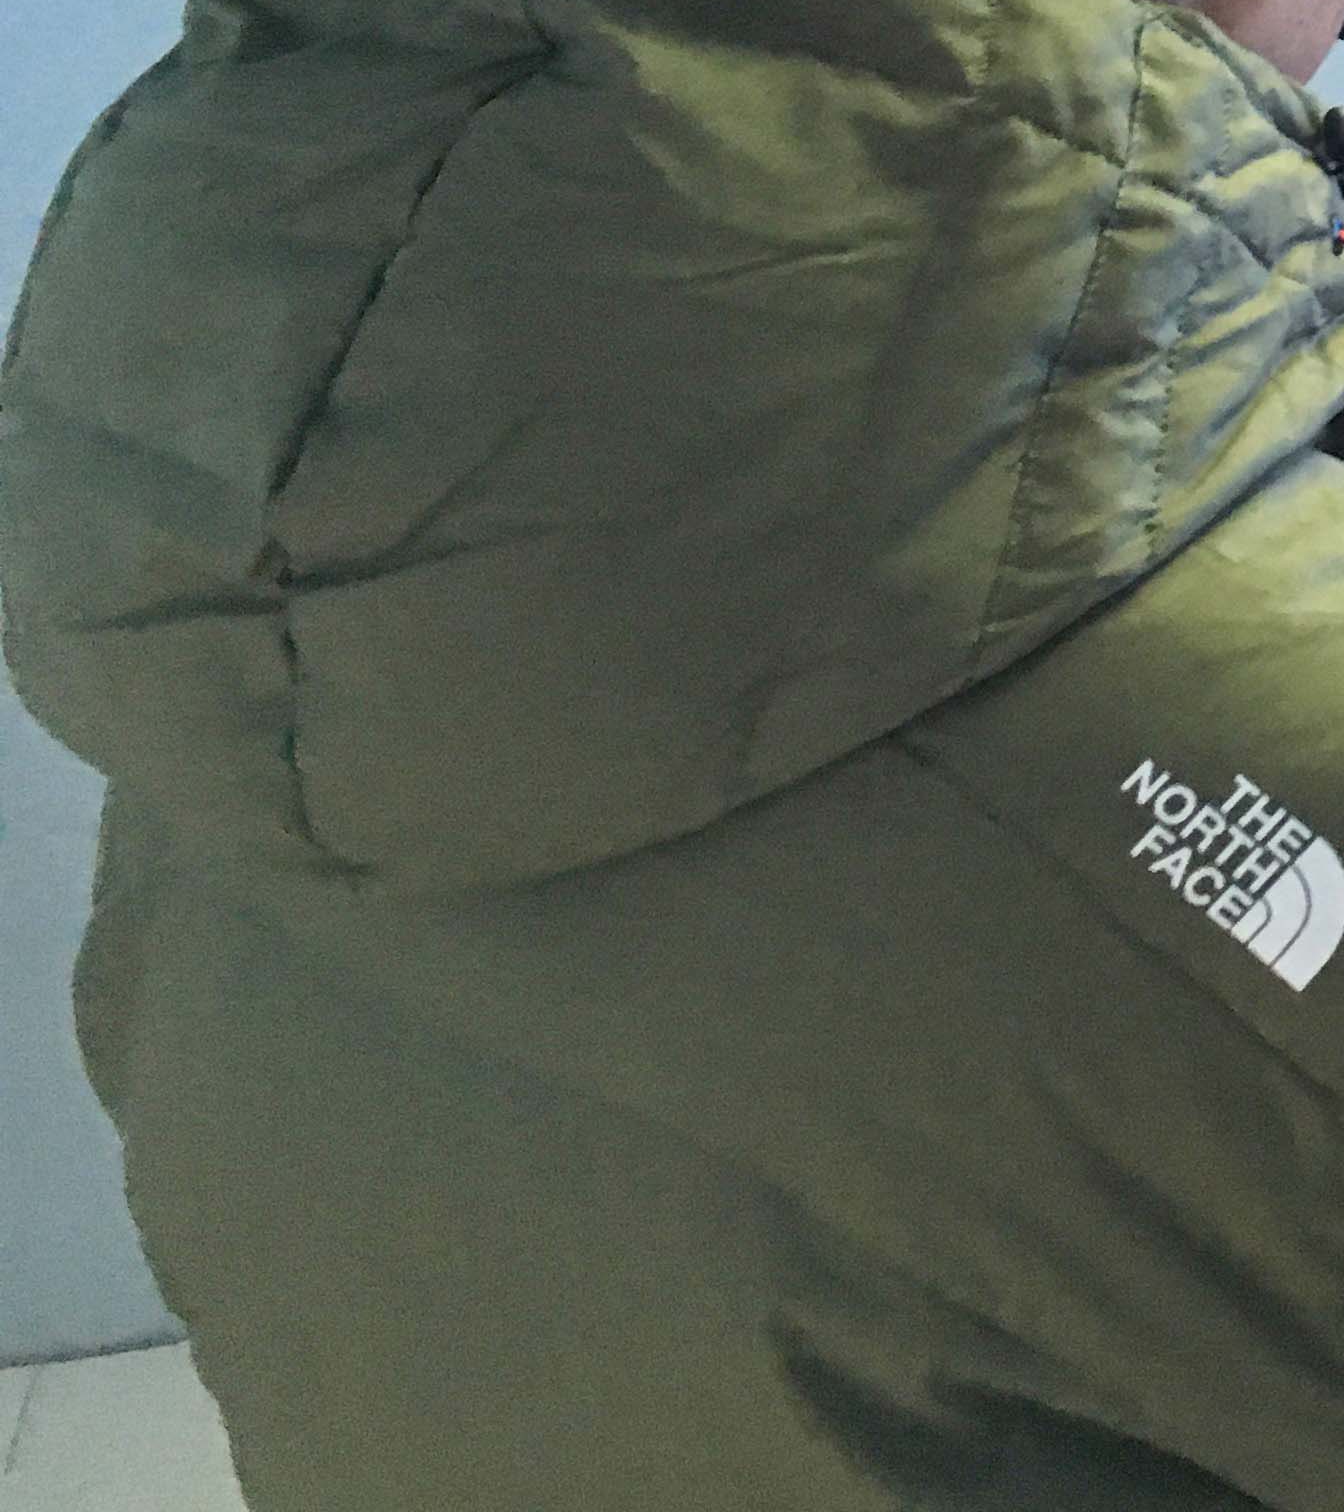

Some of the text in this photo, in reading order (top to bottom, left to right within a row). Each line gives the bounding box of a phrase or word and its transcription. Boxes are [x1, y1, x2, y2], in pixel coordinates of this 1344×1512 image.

[1120, 758, 1281, 894] NORTH
[1220, 774, 1312, 863] THE
[1129, 825, 1253, 930] FACE
